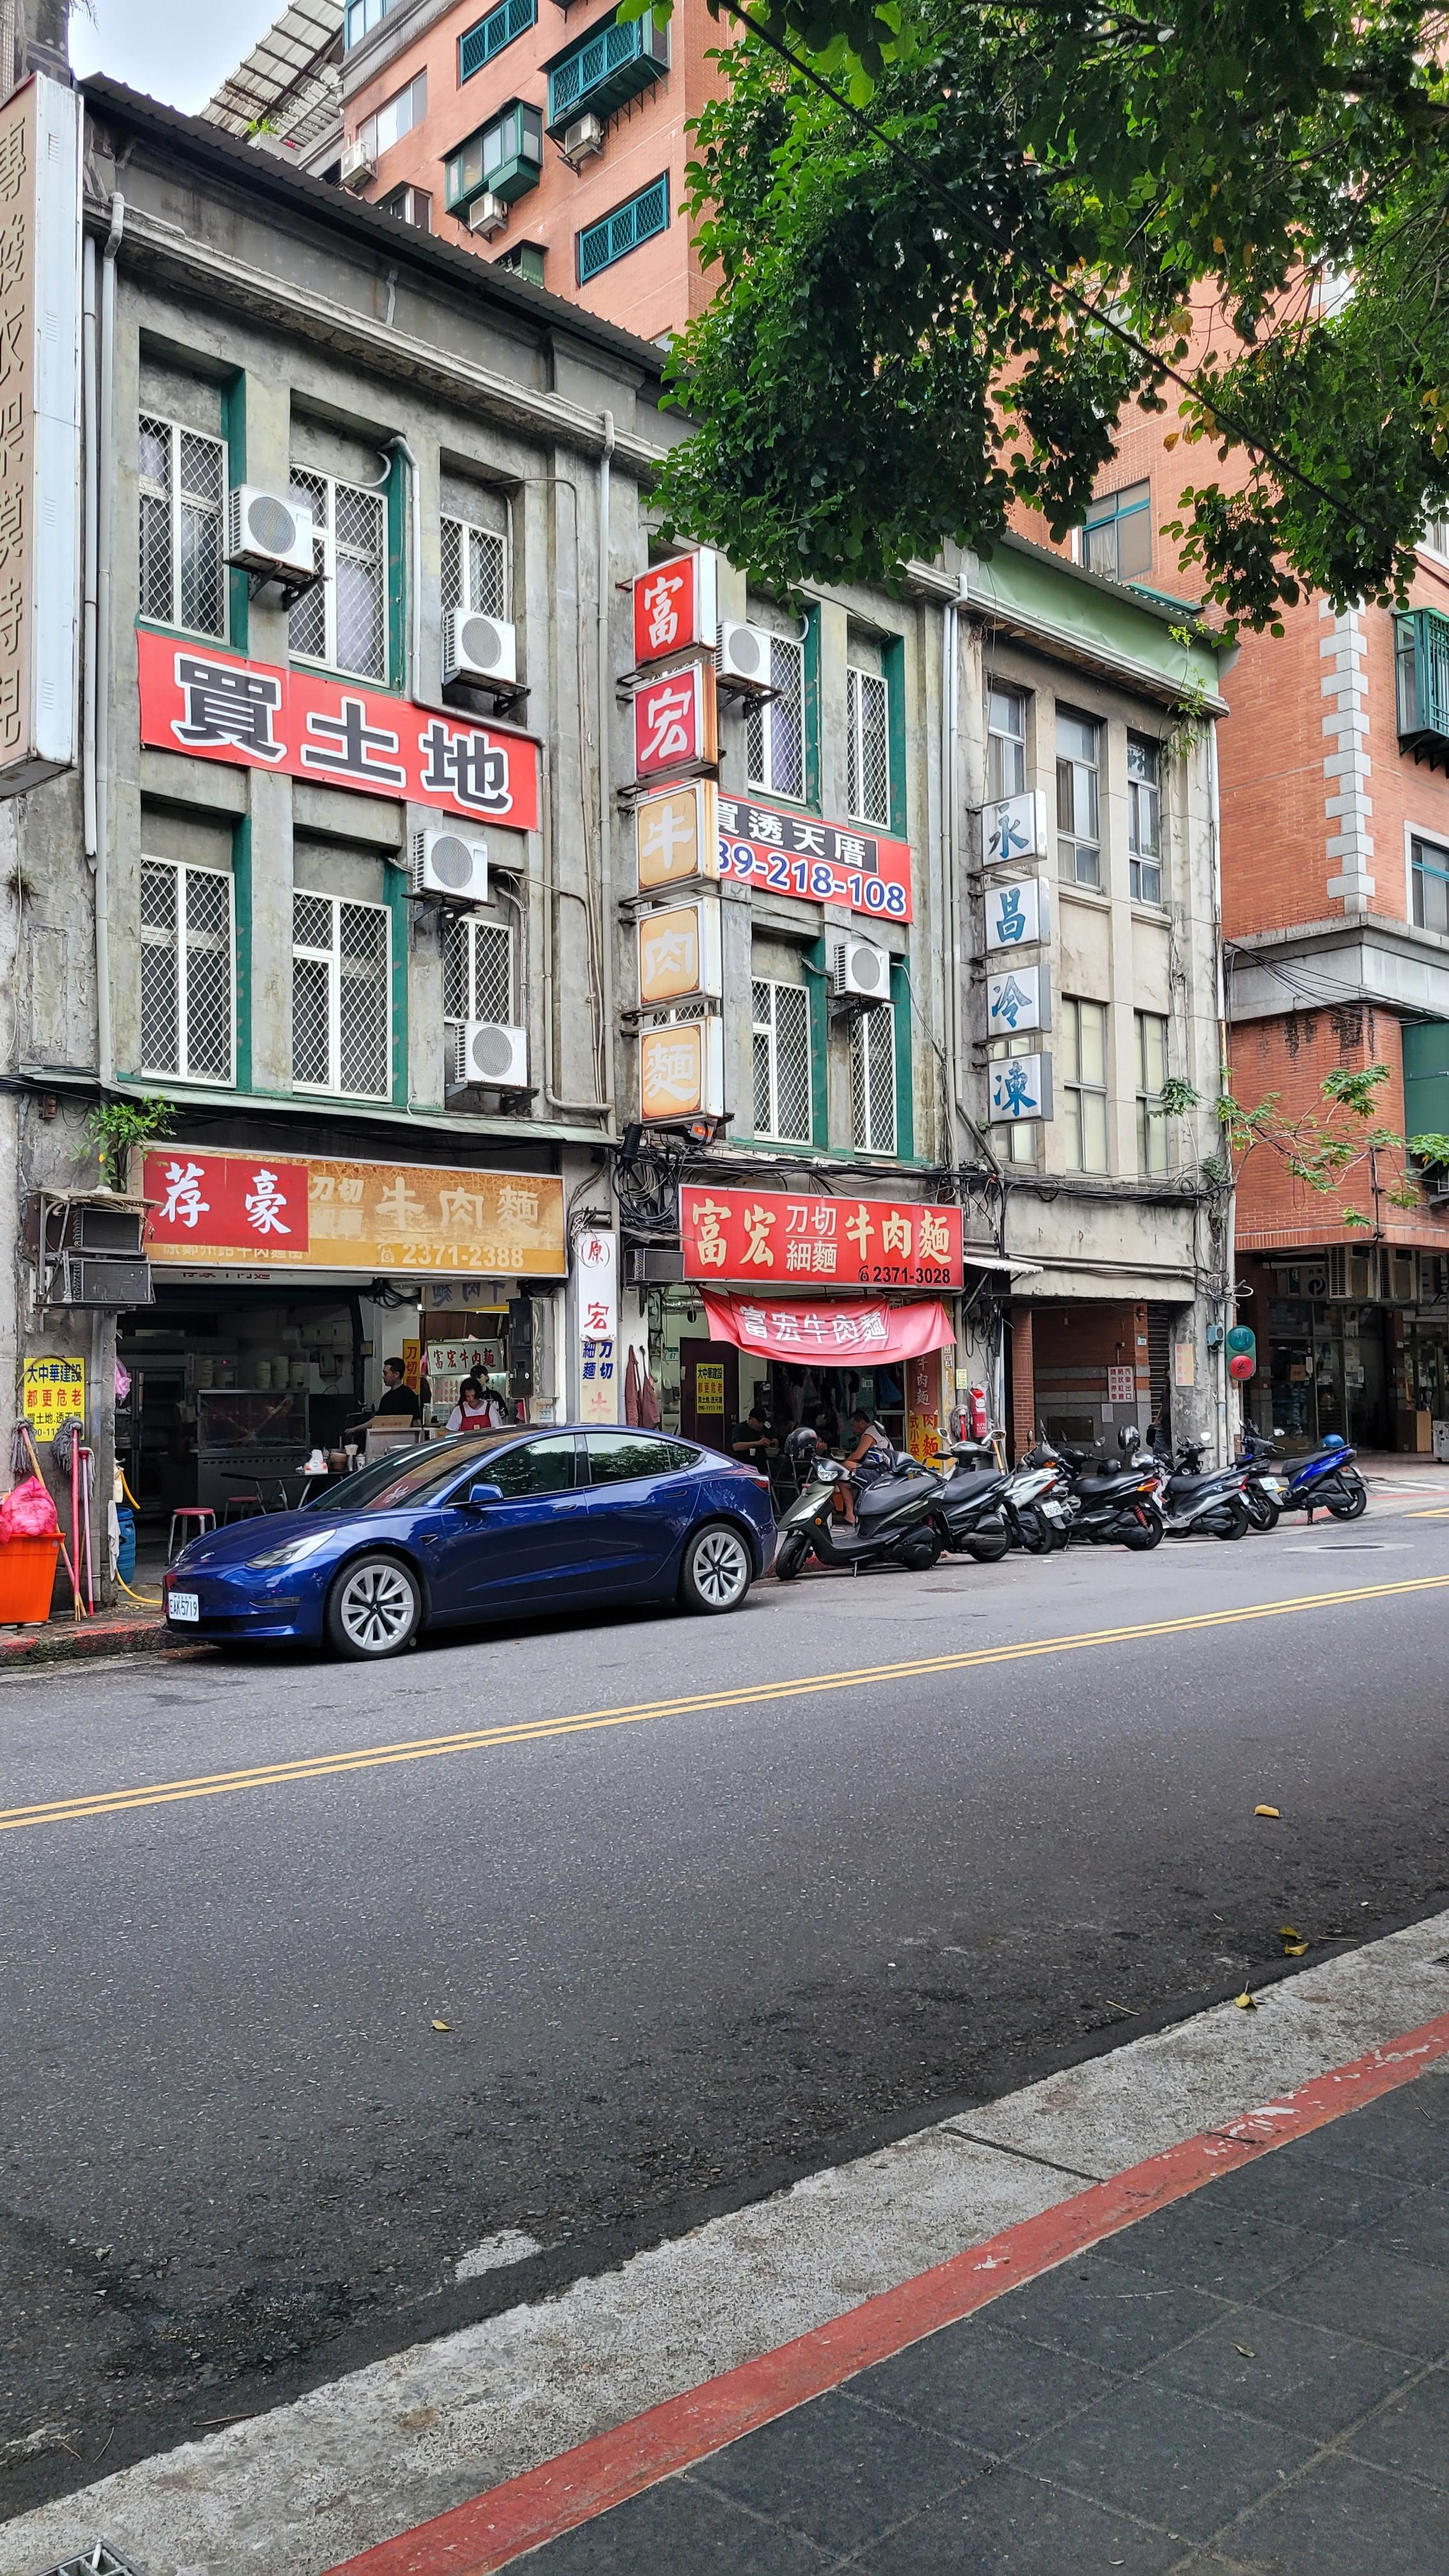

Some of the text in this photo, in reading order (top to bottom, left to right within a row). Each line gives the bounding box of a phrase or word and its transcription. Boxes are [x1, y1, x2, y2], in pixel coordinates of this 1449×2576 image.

[171, 652, 512, 814] 買土地
[641, 577, 698, 1101] 富宏牛肉麵
[988, 802, 1037, 1116] 永昌冷凍
[159, 1162, 292, 1234] 荐豪
[309, 1176, 364, 1203] 刀切
[375, 1176, 543, 1237] 牛肉麵
[693, 1198, 952, 1268] 富宏 牛肉麵
[785, 1205, 836, 1236] 刀切
[402, 1244, 523, 1268] 2371-2388
[785, 1239, 838, 1273] 細麵
[873, 1266, 951, 1284] 2371-3028
[584, 1302, 609, 1330] 宏
[739, 1305, 889, 1344] 富宏牛肉麵
[27, 1363, 82, 1383] 大中華建設
[434, 1347, 496, 1370] 富宏牛肉麵
[583, 1342, 597, 1379] 細麵
[599, 1342, 613, 1379] 刀切
[698, 1367, 723, 1379] 大中華建設
[27, 1388, 82, 1407] 都更危老
